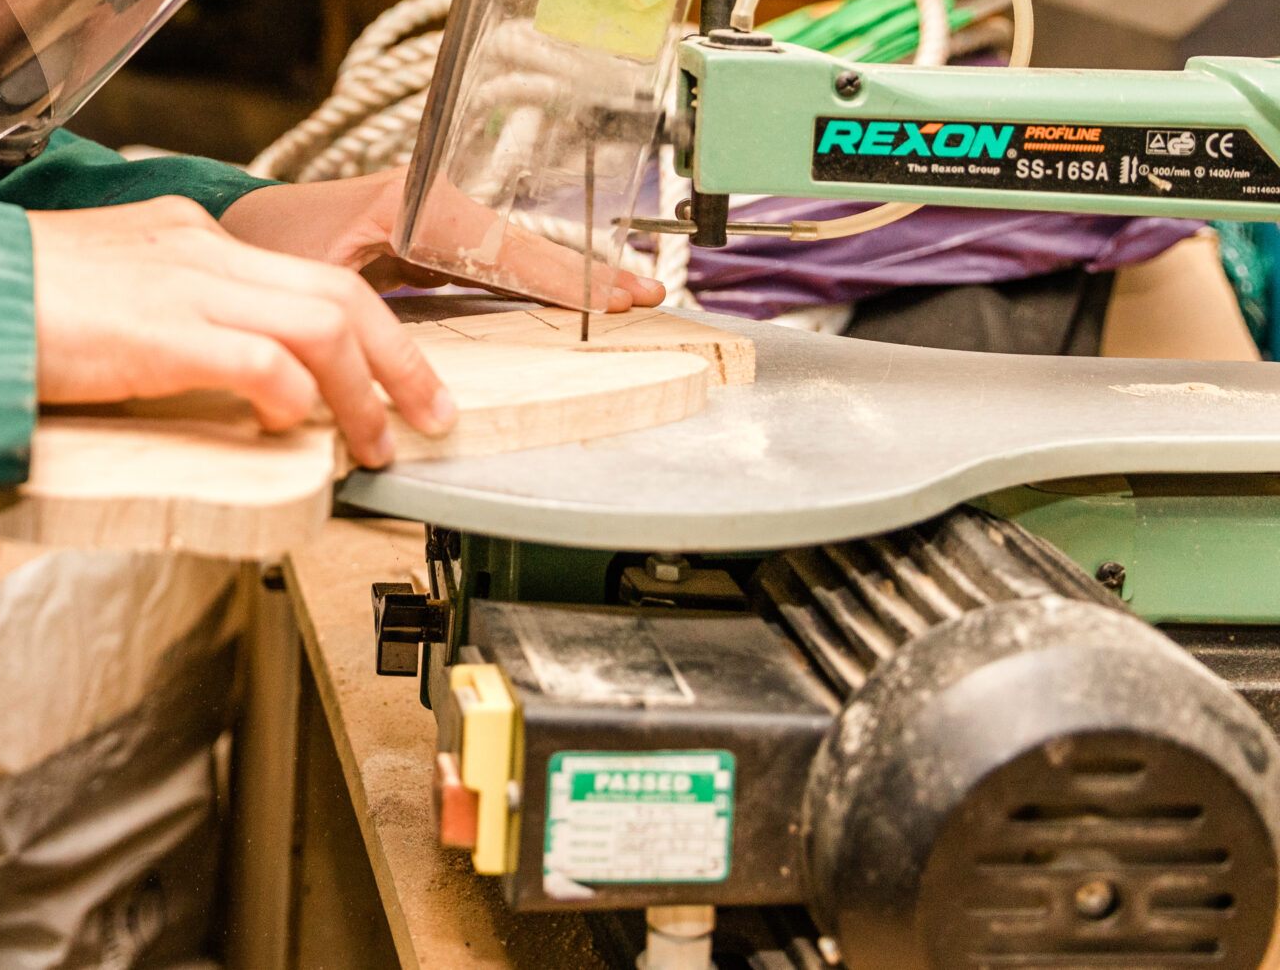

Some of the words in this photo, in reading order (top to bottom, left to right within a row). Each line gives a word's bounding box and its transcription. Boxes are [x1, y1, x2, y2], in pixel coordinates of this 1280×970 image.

[816, 119, 1015, 159] REXON
[1024, 125, 1102, 142] PROFILINE
[1205, 132, 1234, 158] CE
[907, 163, 928, 173] The
[931, 164, 965, 174] Rexon
[968, 164, 1001, 175] Group
[1016, 158, 1109, 181] SS-16SA
[1153, 165, 1191, 178] 900/min
[1209, 166, 1251, 179] 1400/min
[593, 772, 693, 793] PASSED
